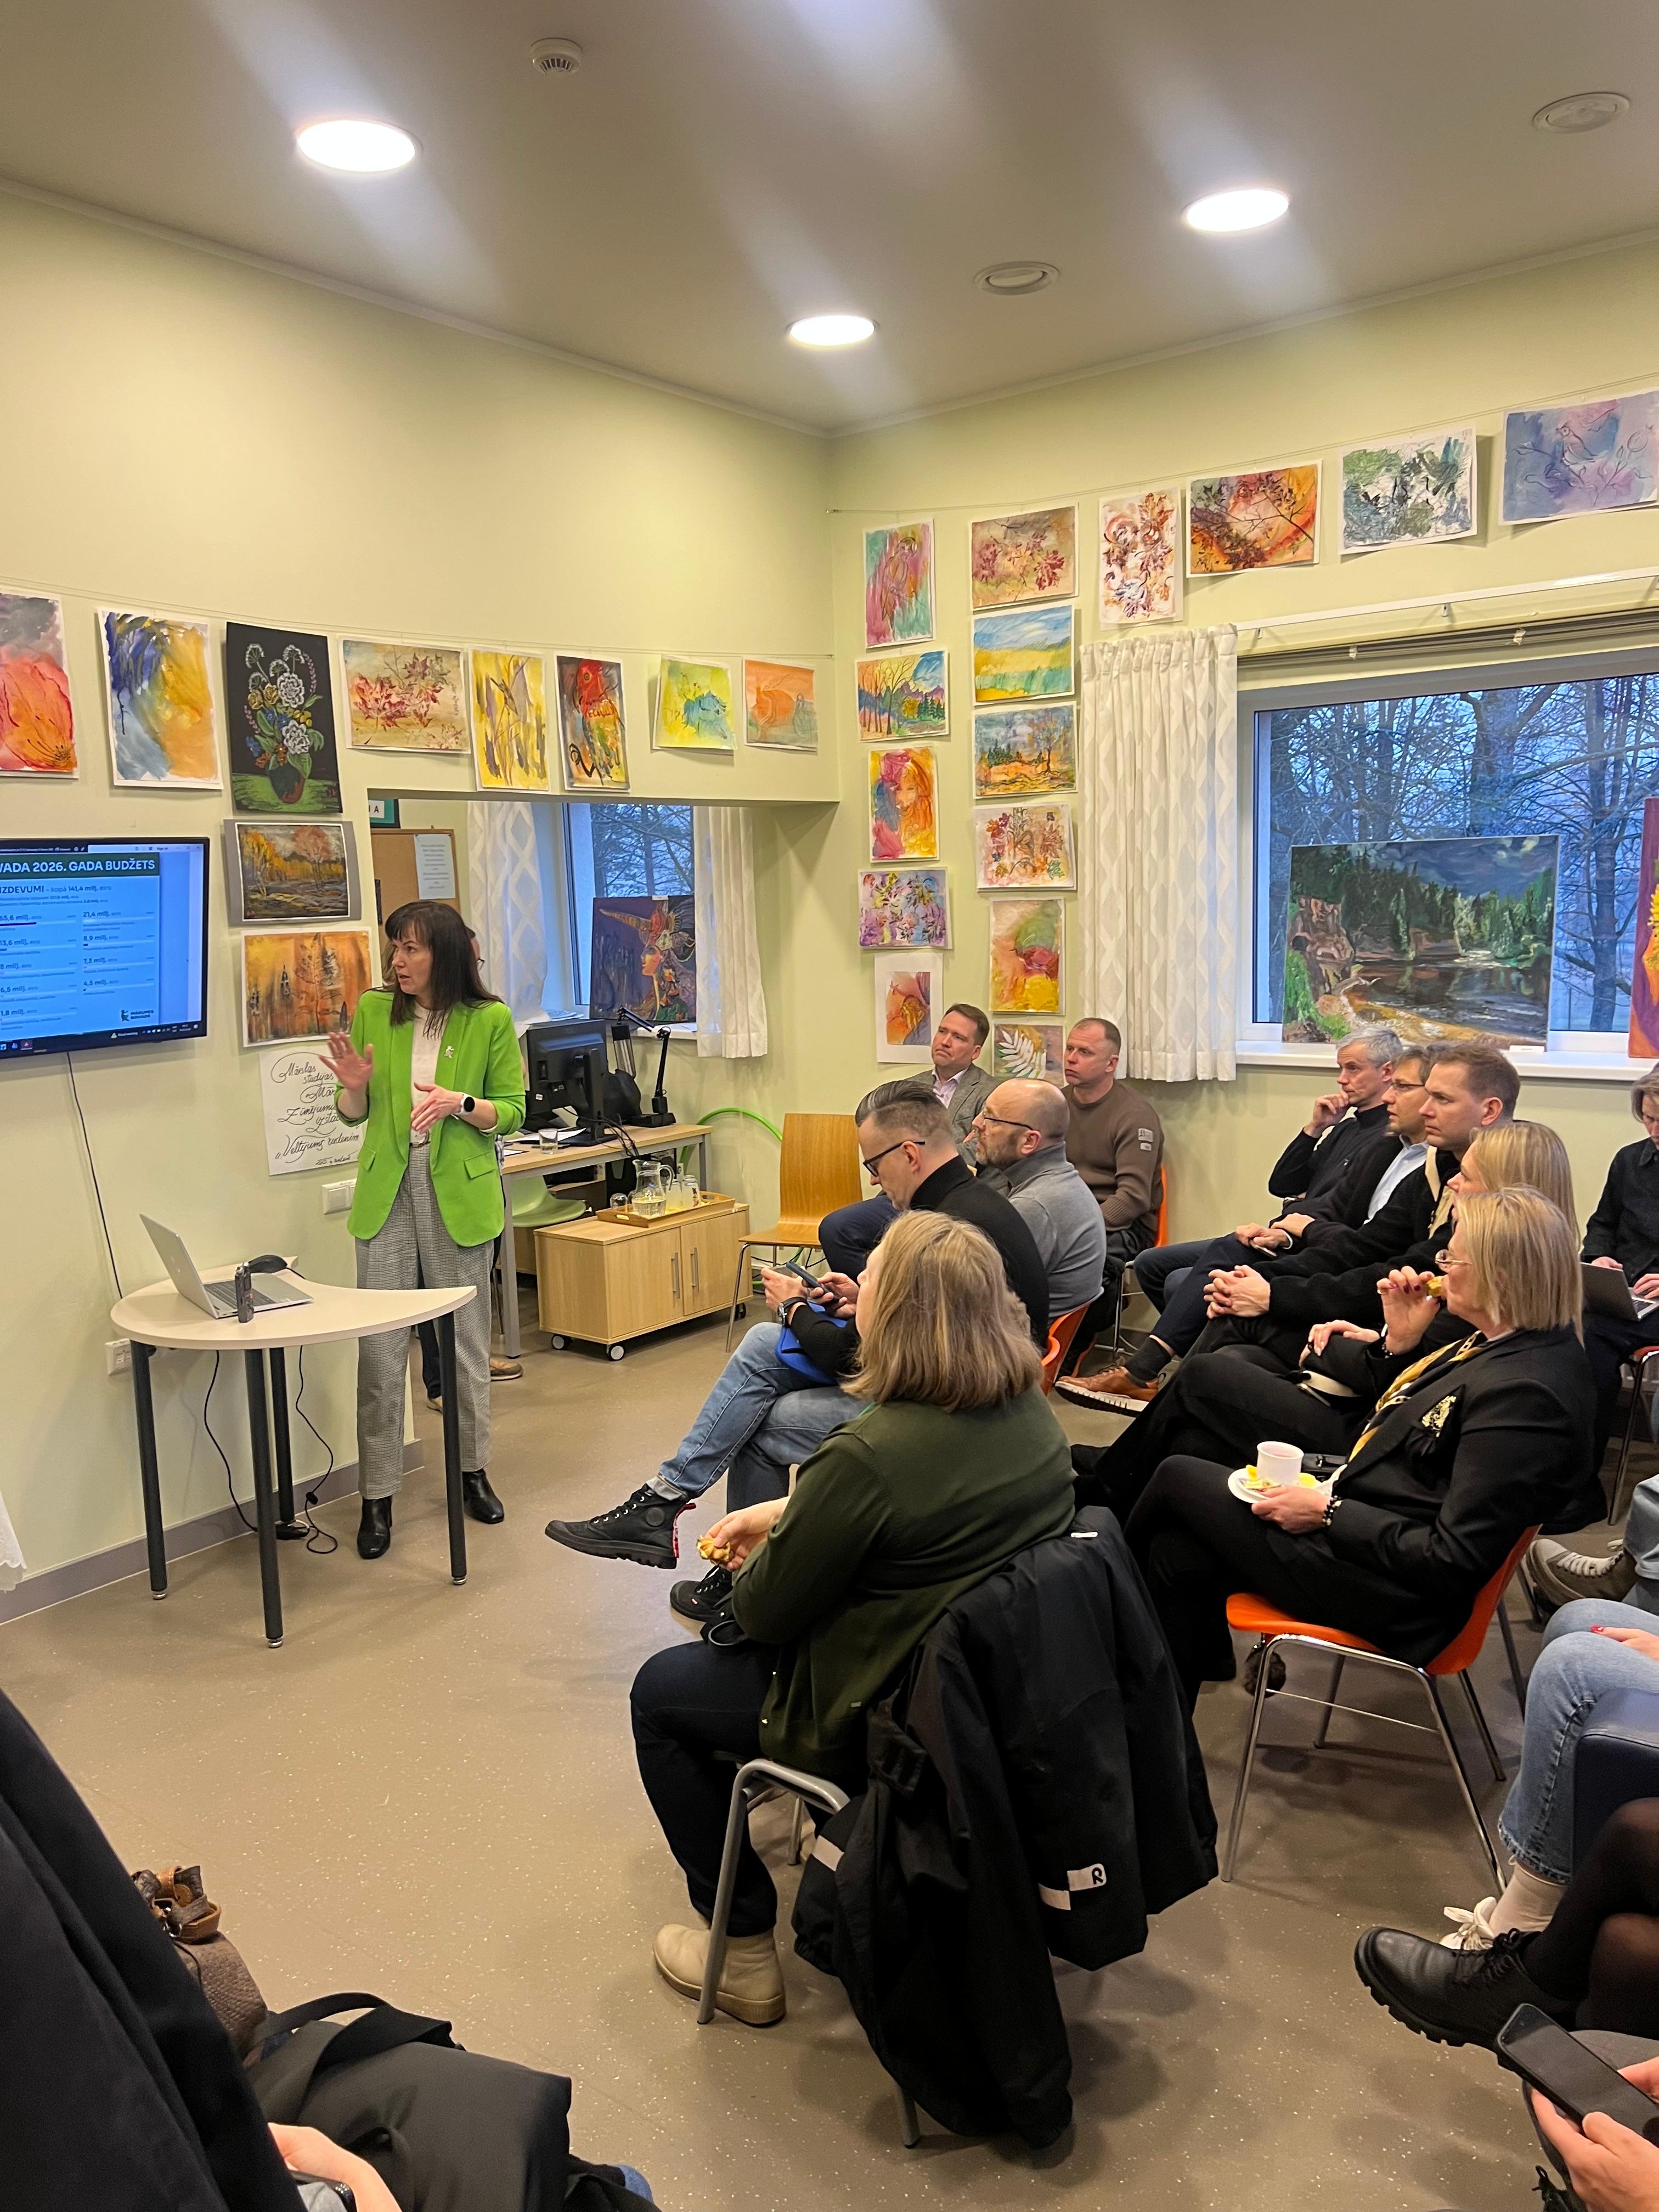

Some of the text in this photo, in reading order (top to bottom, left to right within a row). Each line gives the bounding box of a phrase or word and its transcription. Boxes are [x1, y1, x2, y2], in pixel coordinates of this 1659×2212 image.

[33, 862, 66, 872] 2026.
[69, 861, 103, 871] GADA
[105, 857, 155, 871] BUDŽETS
